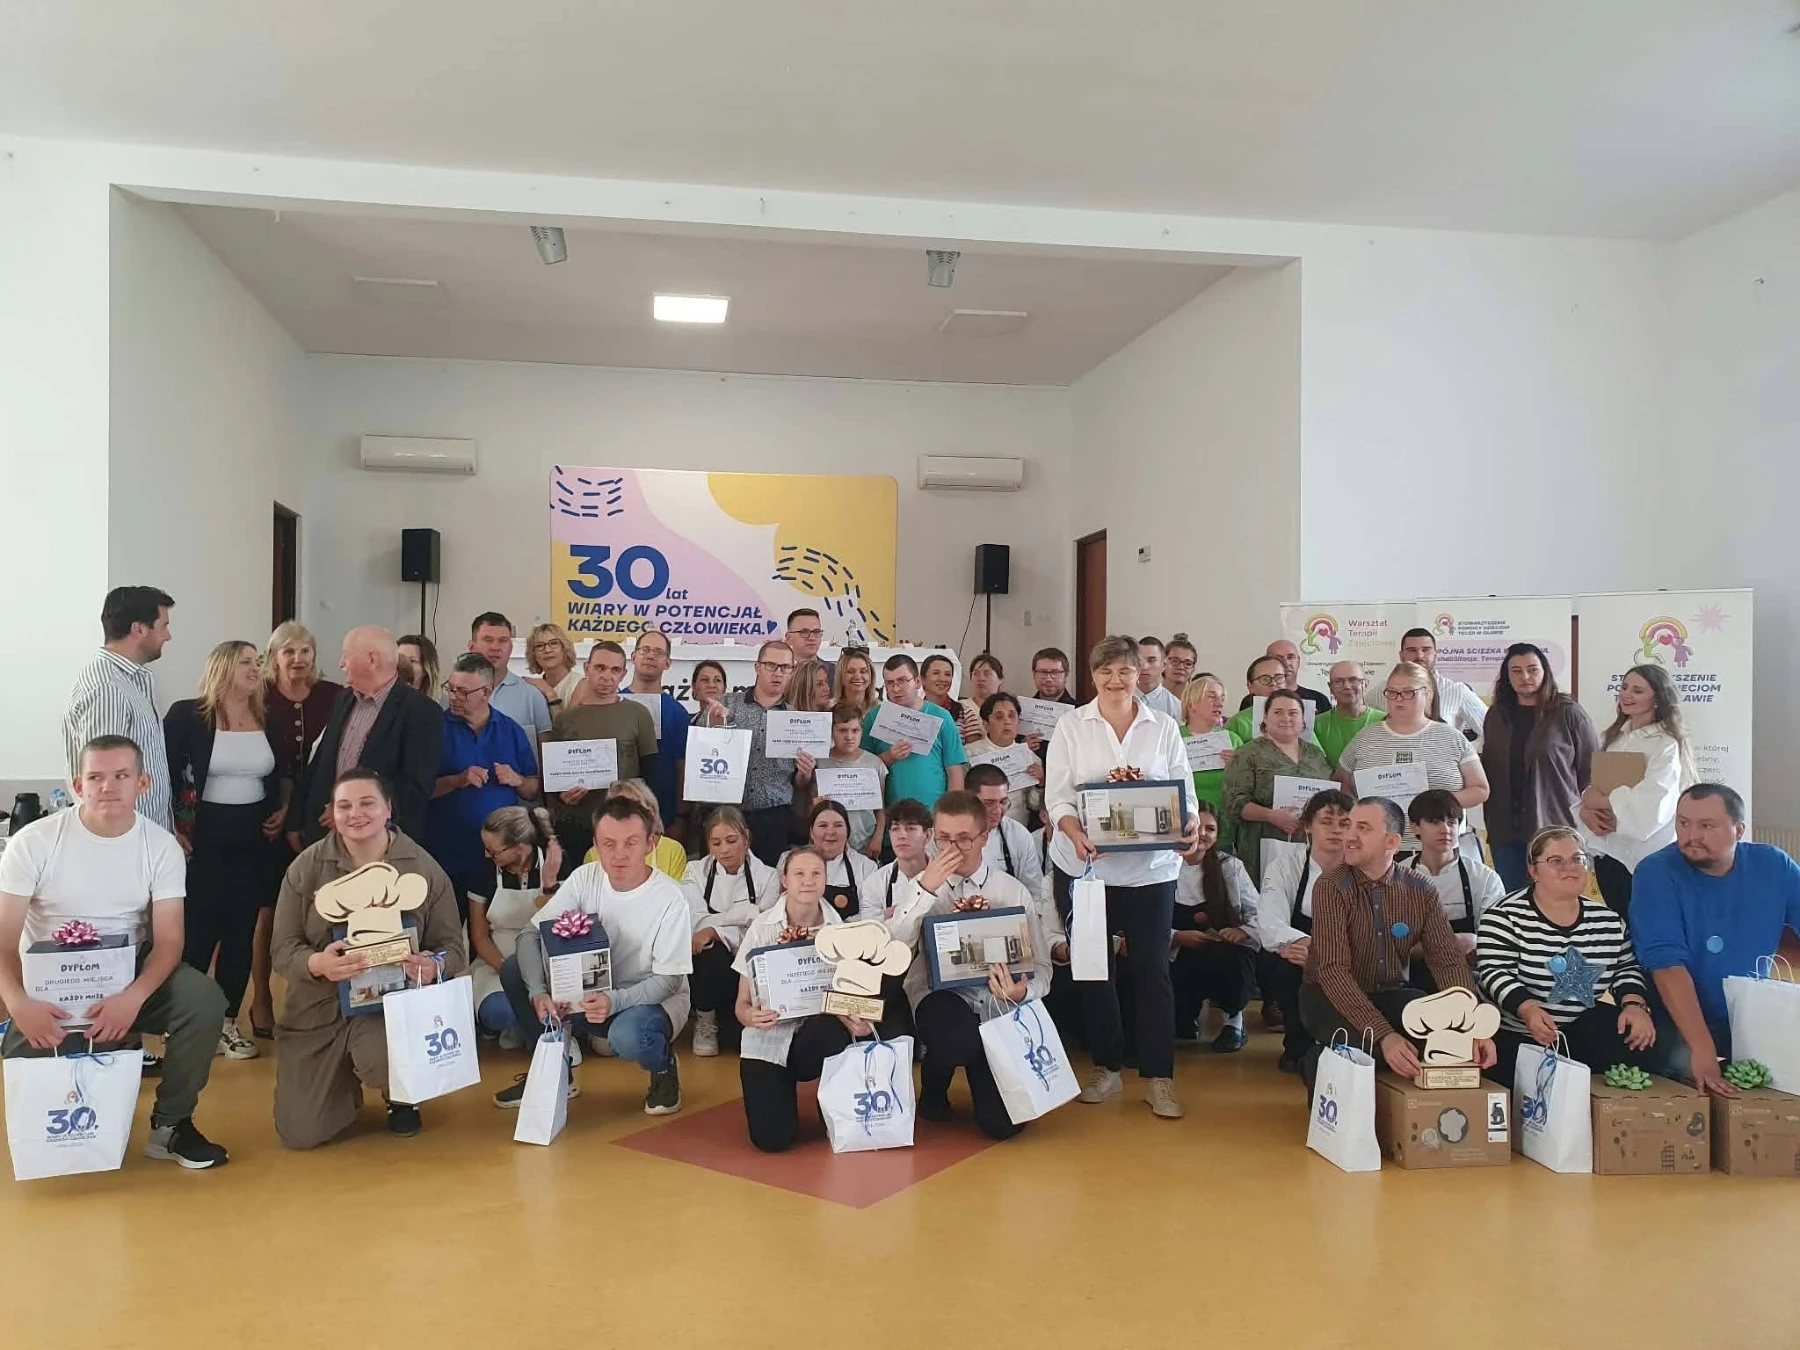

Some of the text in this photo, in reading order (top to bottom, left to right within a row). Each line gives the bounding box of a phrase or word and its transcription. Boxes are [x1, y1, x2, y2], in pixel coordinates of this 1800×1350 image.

[567, 544, 689, 600] 30 lat
[567, 602, 763, 618] WIARY W POTENCJAŁ
[567, 616, 654, 633] KAŻDEGO
[1348, 629, 1378, 638] Terapii
[1683, 694, 1714, 702] AWIE
[700, 759, 728, 774] 30
[60, 963, 100, 972] DYPLOM
[798, 957, 822, 966] DYPLO
[425, 1027, 459, 1057] 30
[854, 1090, 891, 1116] 30
[1318, 1094, 1338, 1124] 30
[46, 1106, 97, 1135] 30
